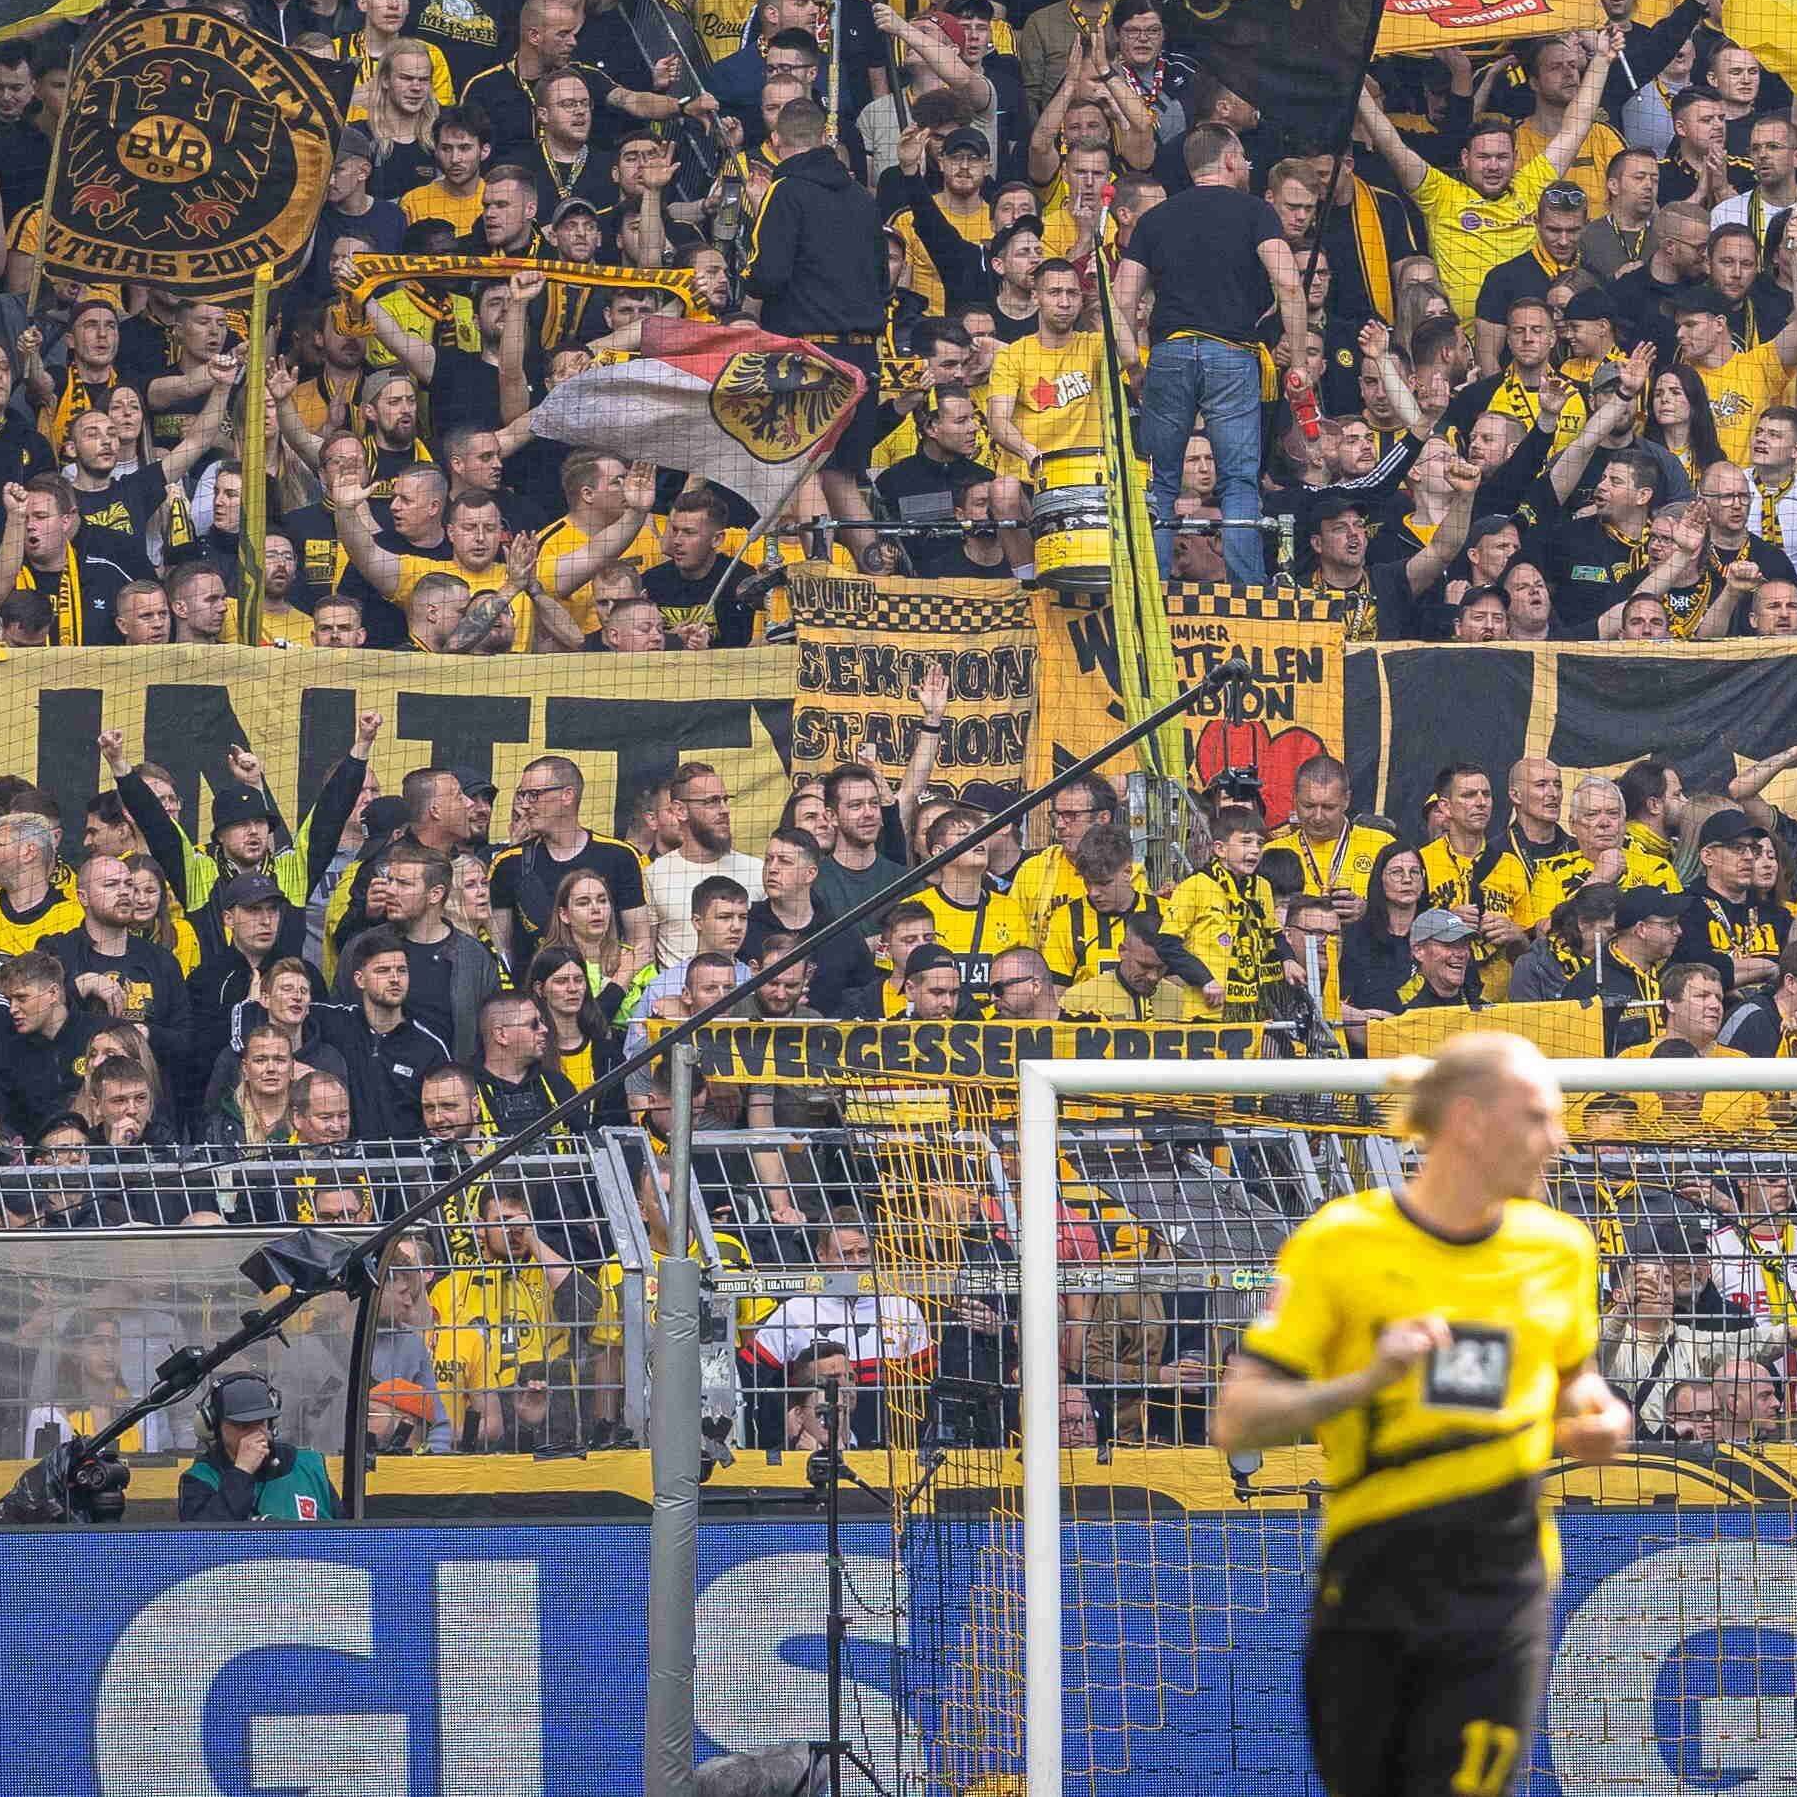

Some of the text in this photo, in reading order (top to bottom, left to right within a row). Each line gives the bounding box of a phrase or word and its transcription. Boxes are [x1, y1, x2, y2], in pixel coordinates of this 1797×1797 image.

[1450, 0, 1539, 29] DORTMUND
[127, 120, 209, 174] BVB
[146, 161, 177, 179] 09
[188, 235, 286, 278] 2001
[1169, 622, 1229, 644] IMMER
[799, 641, 1037, 702] SEKTION
[694, 1022, 1053, 1082] NVERGESSEN
